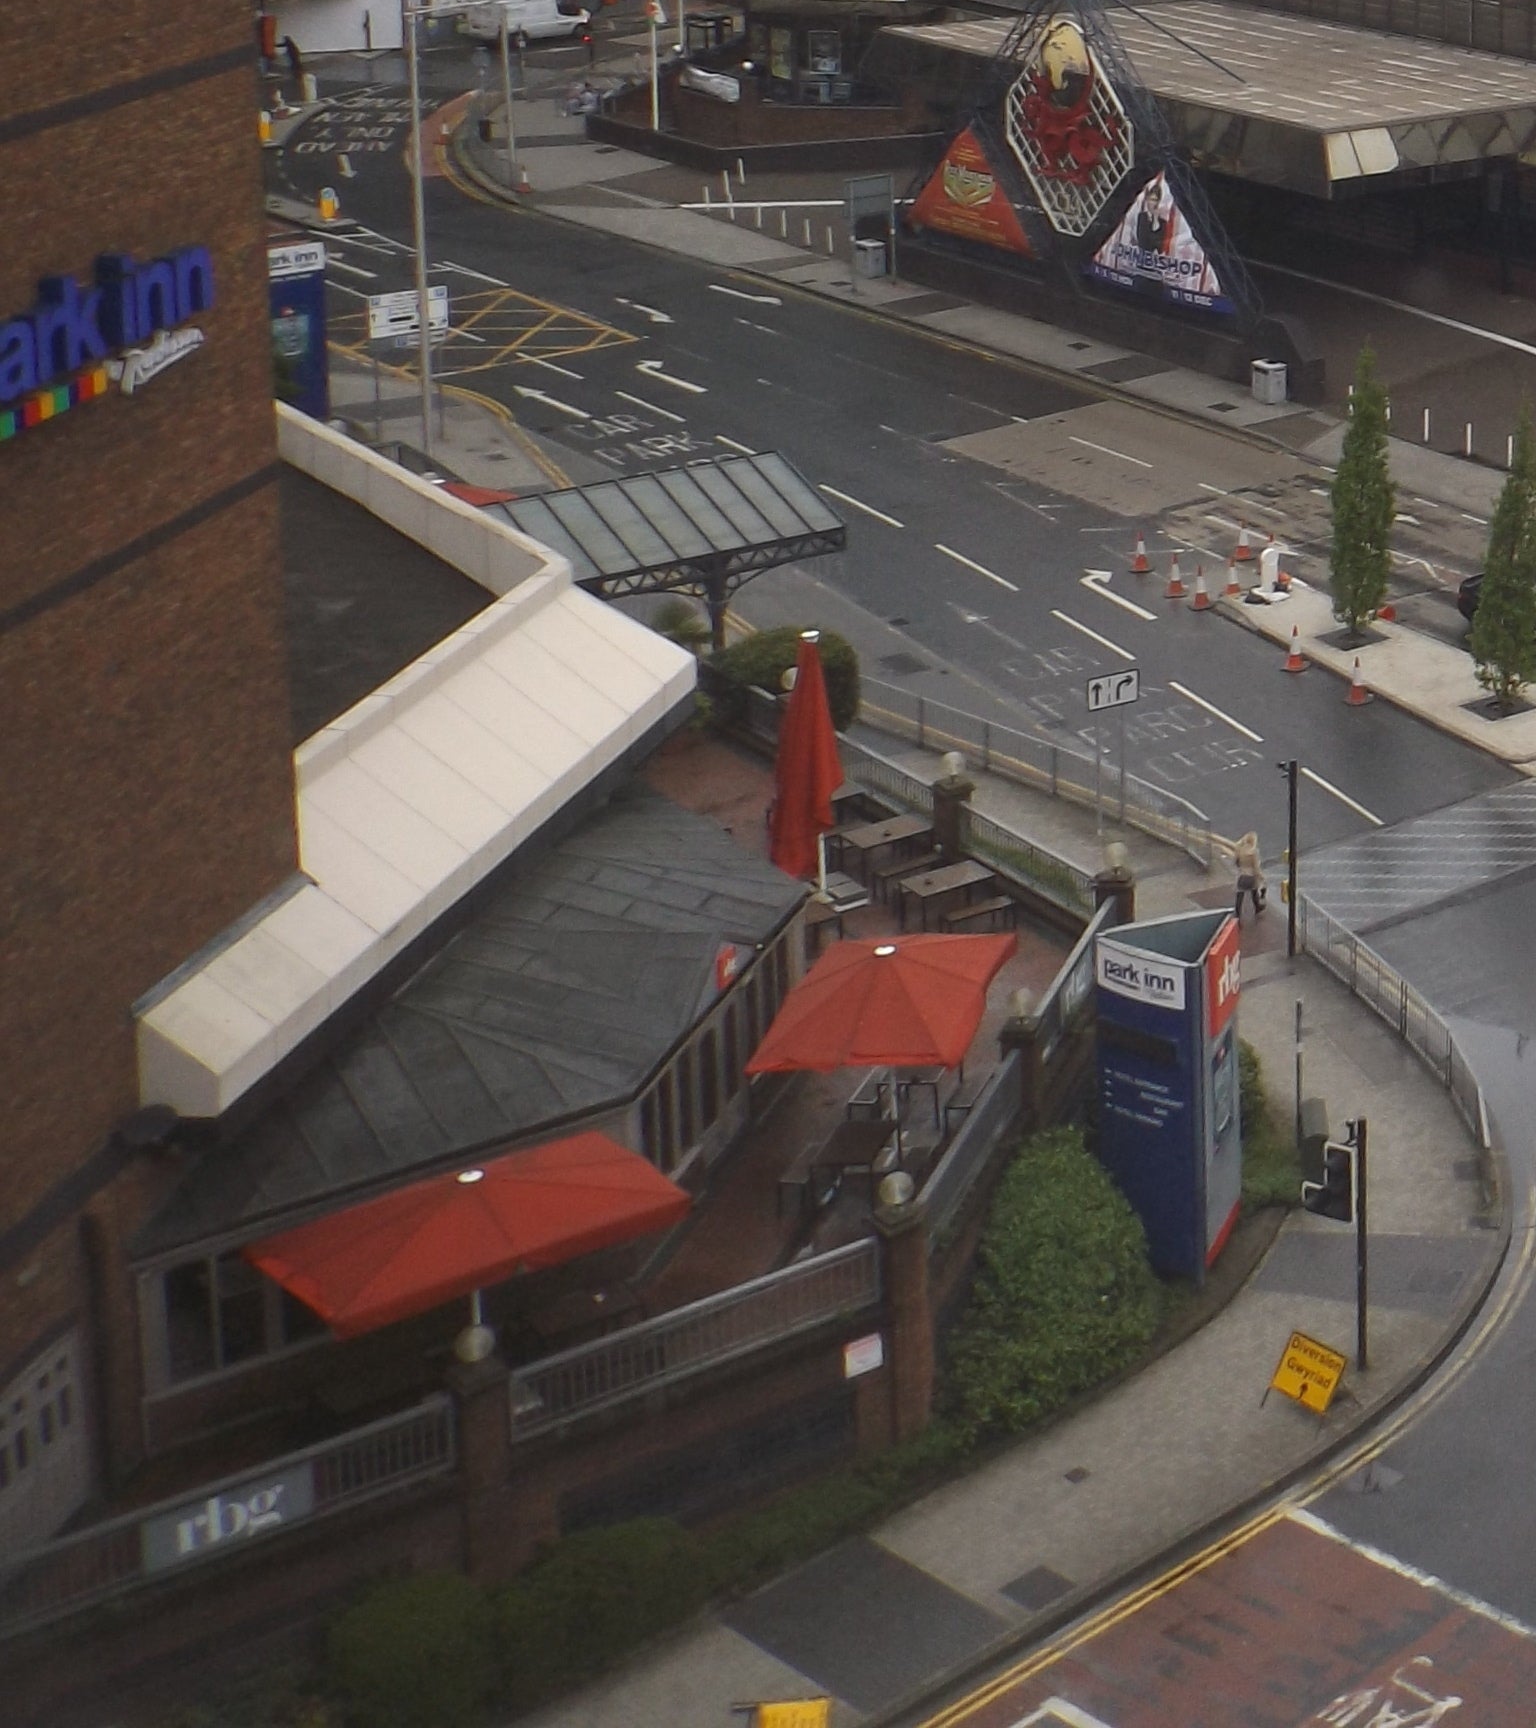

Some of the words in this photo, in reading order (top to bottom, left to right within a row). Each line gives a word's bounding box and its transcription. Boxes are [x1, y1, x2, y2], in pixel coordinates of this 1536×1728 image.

[1142, 250, 1203, 277] BISHOP
[105, 245, 213, 345] inn
[566, 414, 655, 440] CAR
[593, 431, 714, 466] PARK
[1104, 958, 1141, 985] park
[1144, 967, 1175, 992] inn
[1291, 1336, 1342, 1371] Diversion
[1287, 1356, 1333, 1389] Gwyriad
[177, 1482, 285, 1554] rbg
